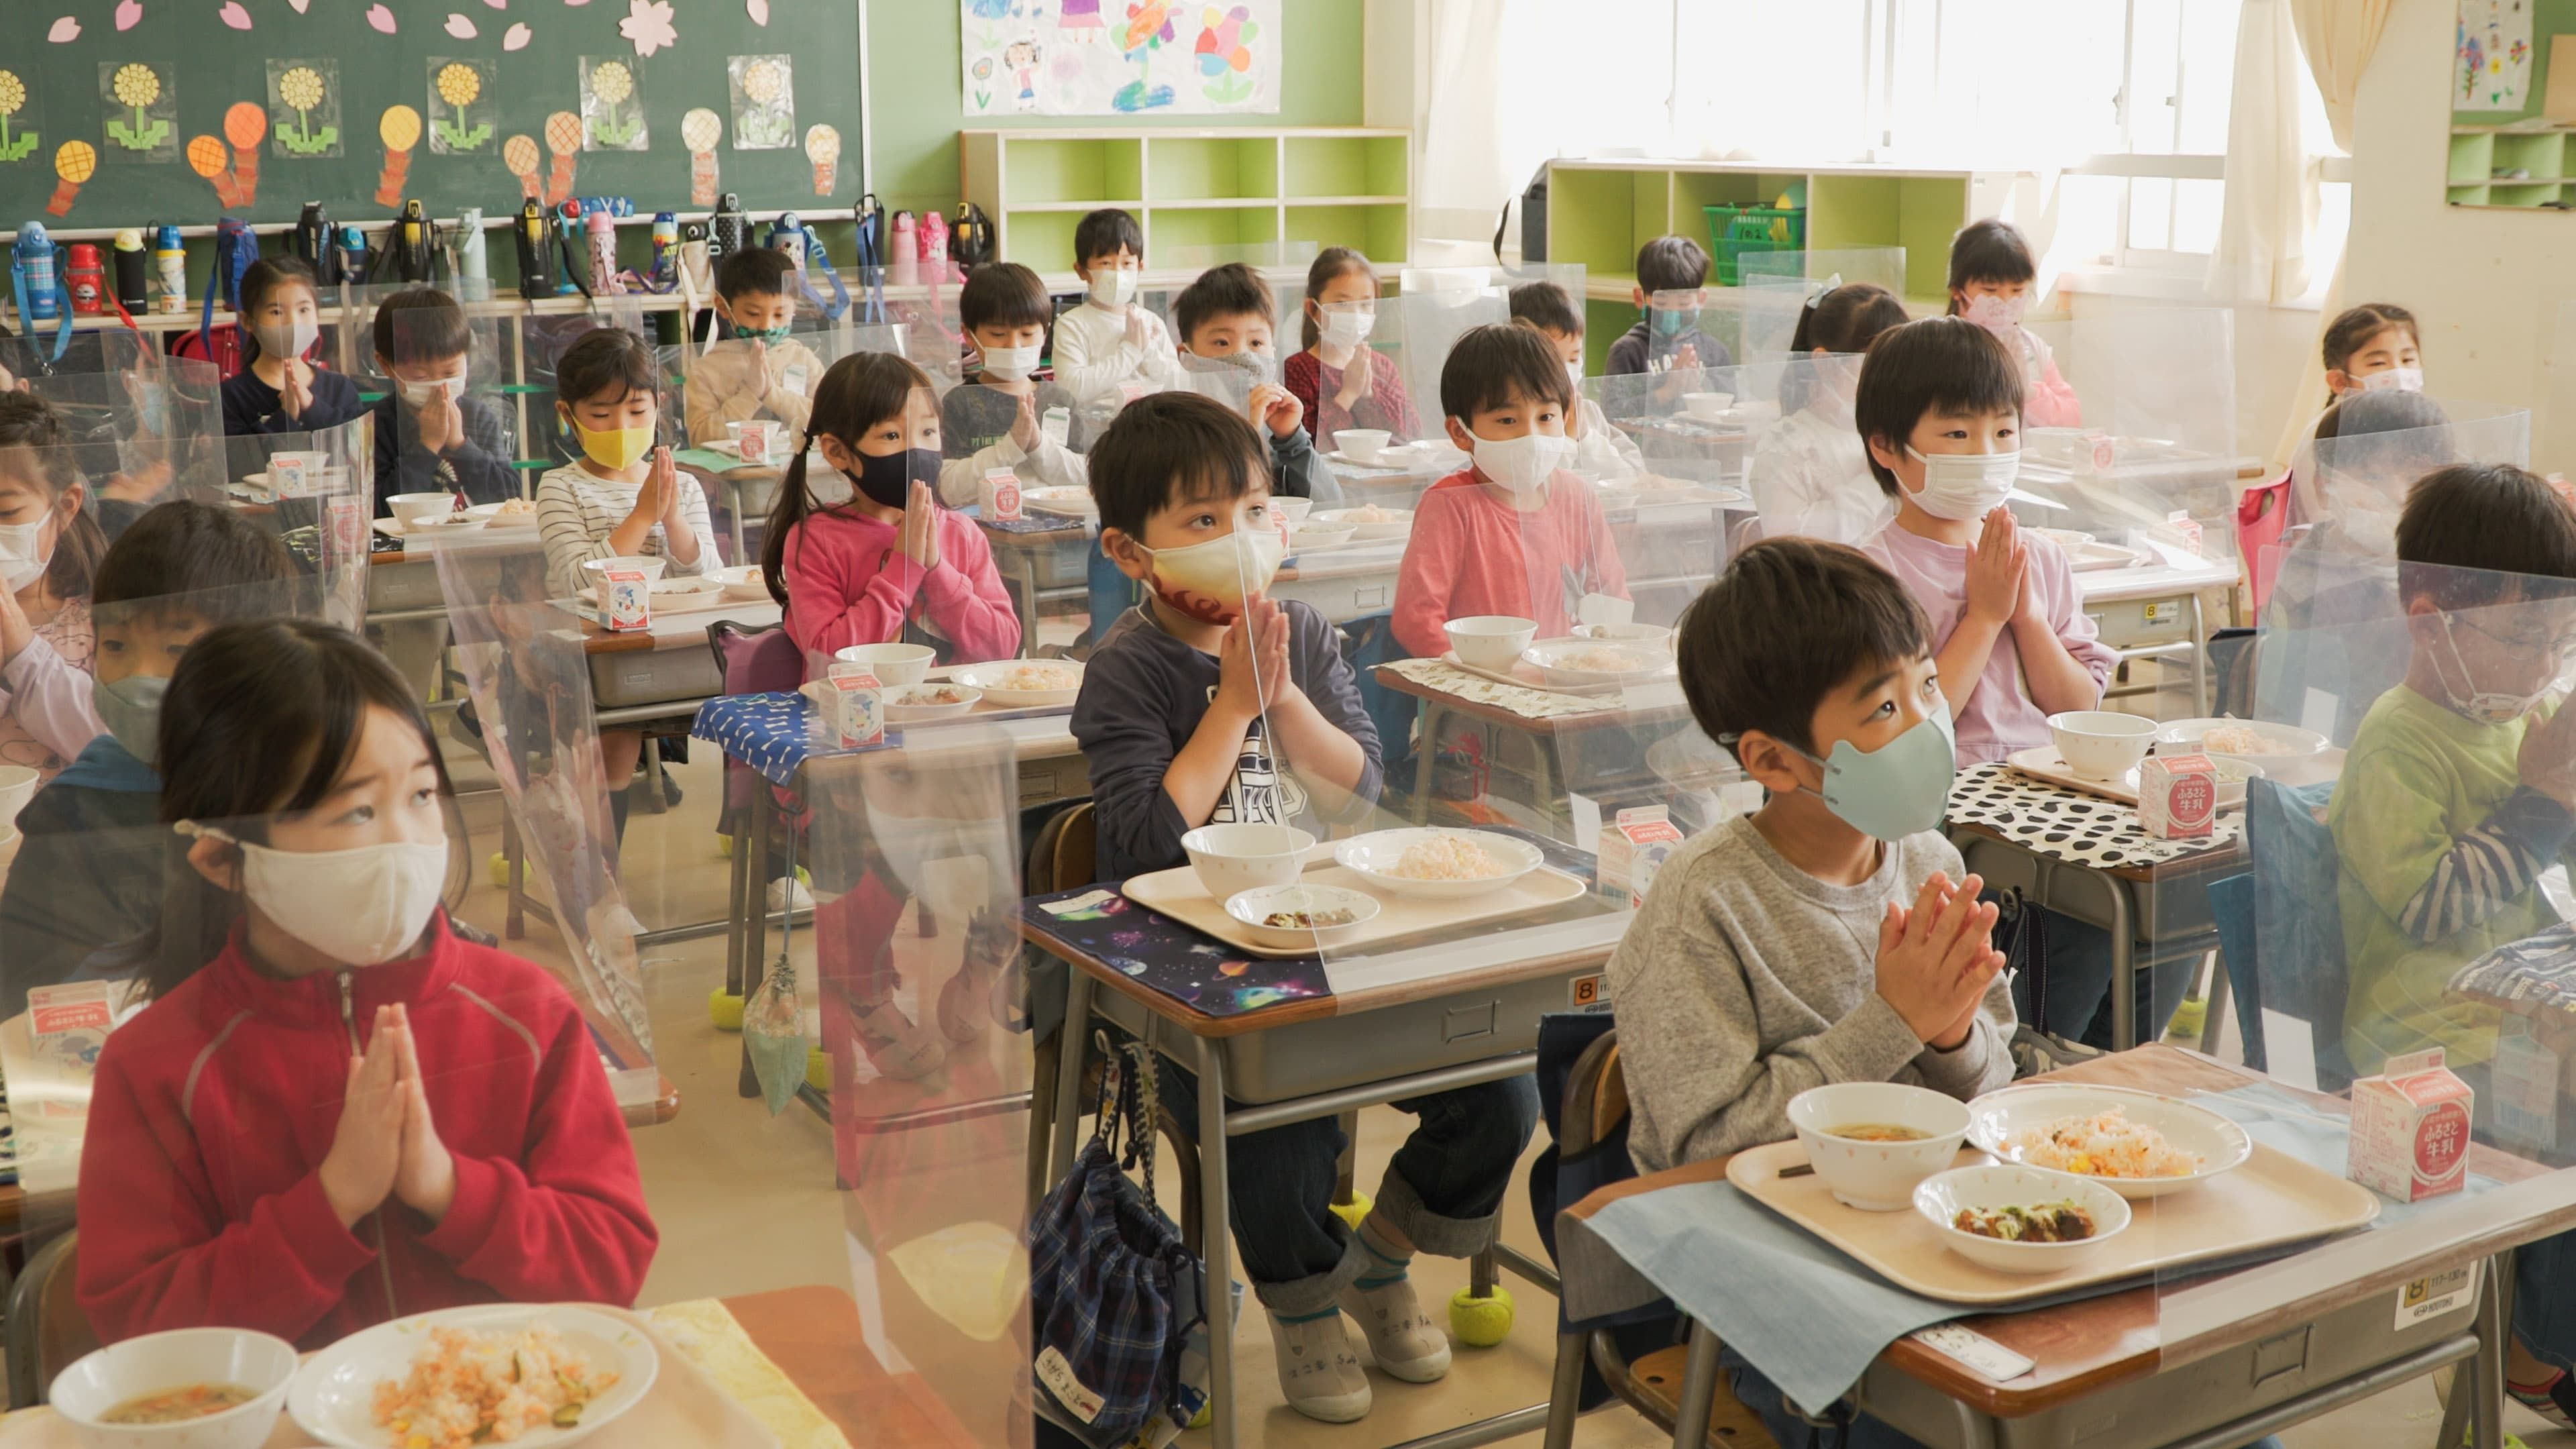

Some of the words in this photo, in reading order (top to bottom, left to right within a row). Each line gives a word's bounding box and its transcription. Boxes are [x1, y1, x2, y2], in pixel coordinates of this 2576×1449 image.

[2147, 606, 2155, 616] 8
[2177, 787, 2206, 800] ふるさと
[2179, 799, 2204, 810] 牛乳
[1579, 982, 1593, 1000] 8
[2424, 1120, 2459, 1142] ふるさと
[2426, 1138, 2455, 1157] 牛乳
